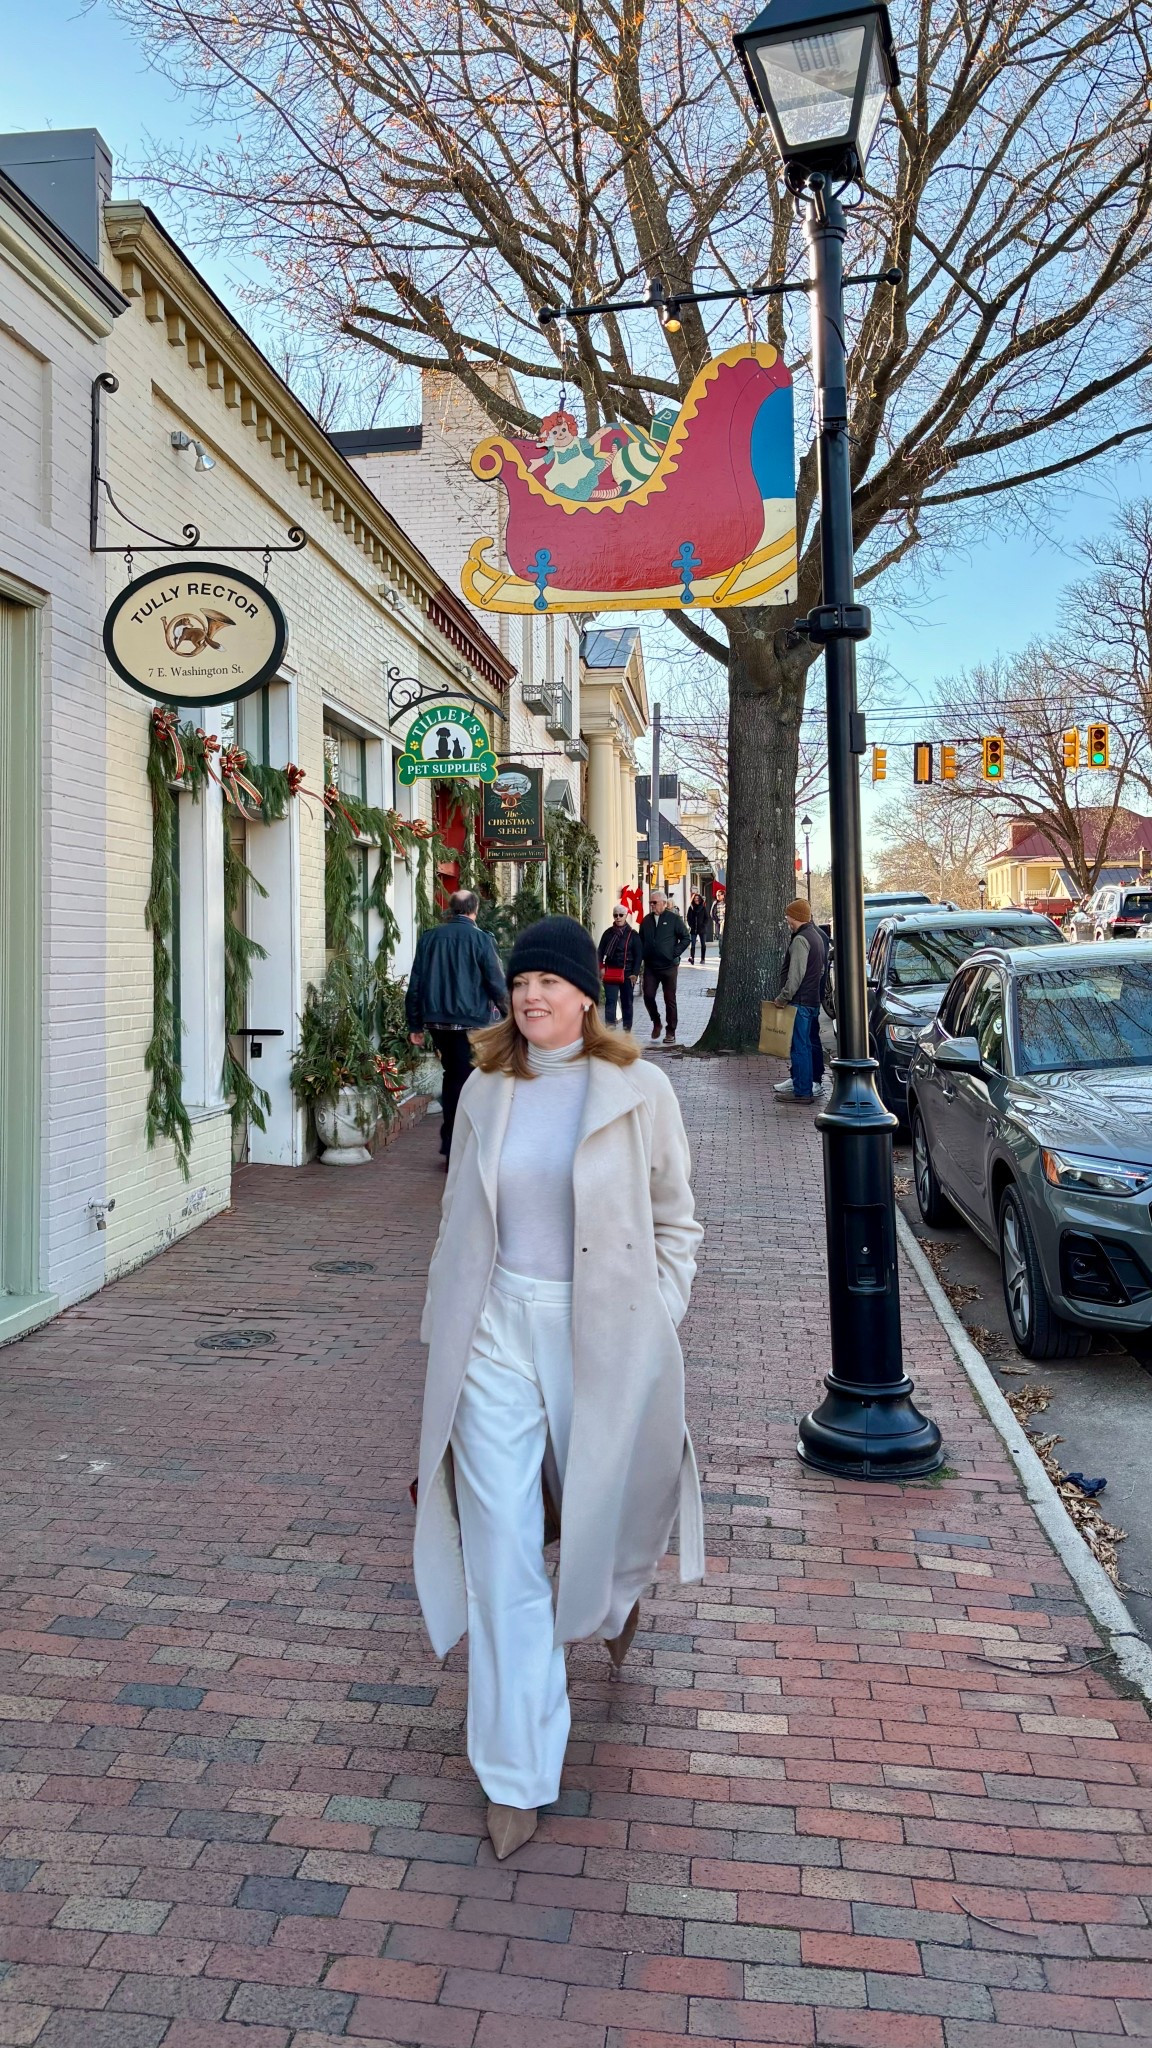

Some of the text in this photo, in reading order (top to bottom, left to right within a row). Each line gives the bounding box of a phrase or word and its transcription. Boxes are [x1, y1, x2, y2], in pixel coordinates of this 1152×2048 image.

[130, 582, 259, 625] TULLY RECTOR
[148, 664, 244, 679] 7 E. Washington St.
[411, 708, 481, 738] TILLEY'S
[407, 762, 487, 775] PET SUPPLIES
[504, 809, 522, 818] The
[487, 818, 535, 826] CHRISTMAS
[497, 827, 527, 835] SLEIGH
